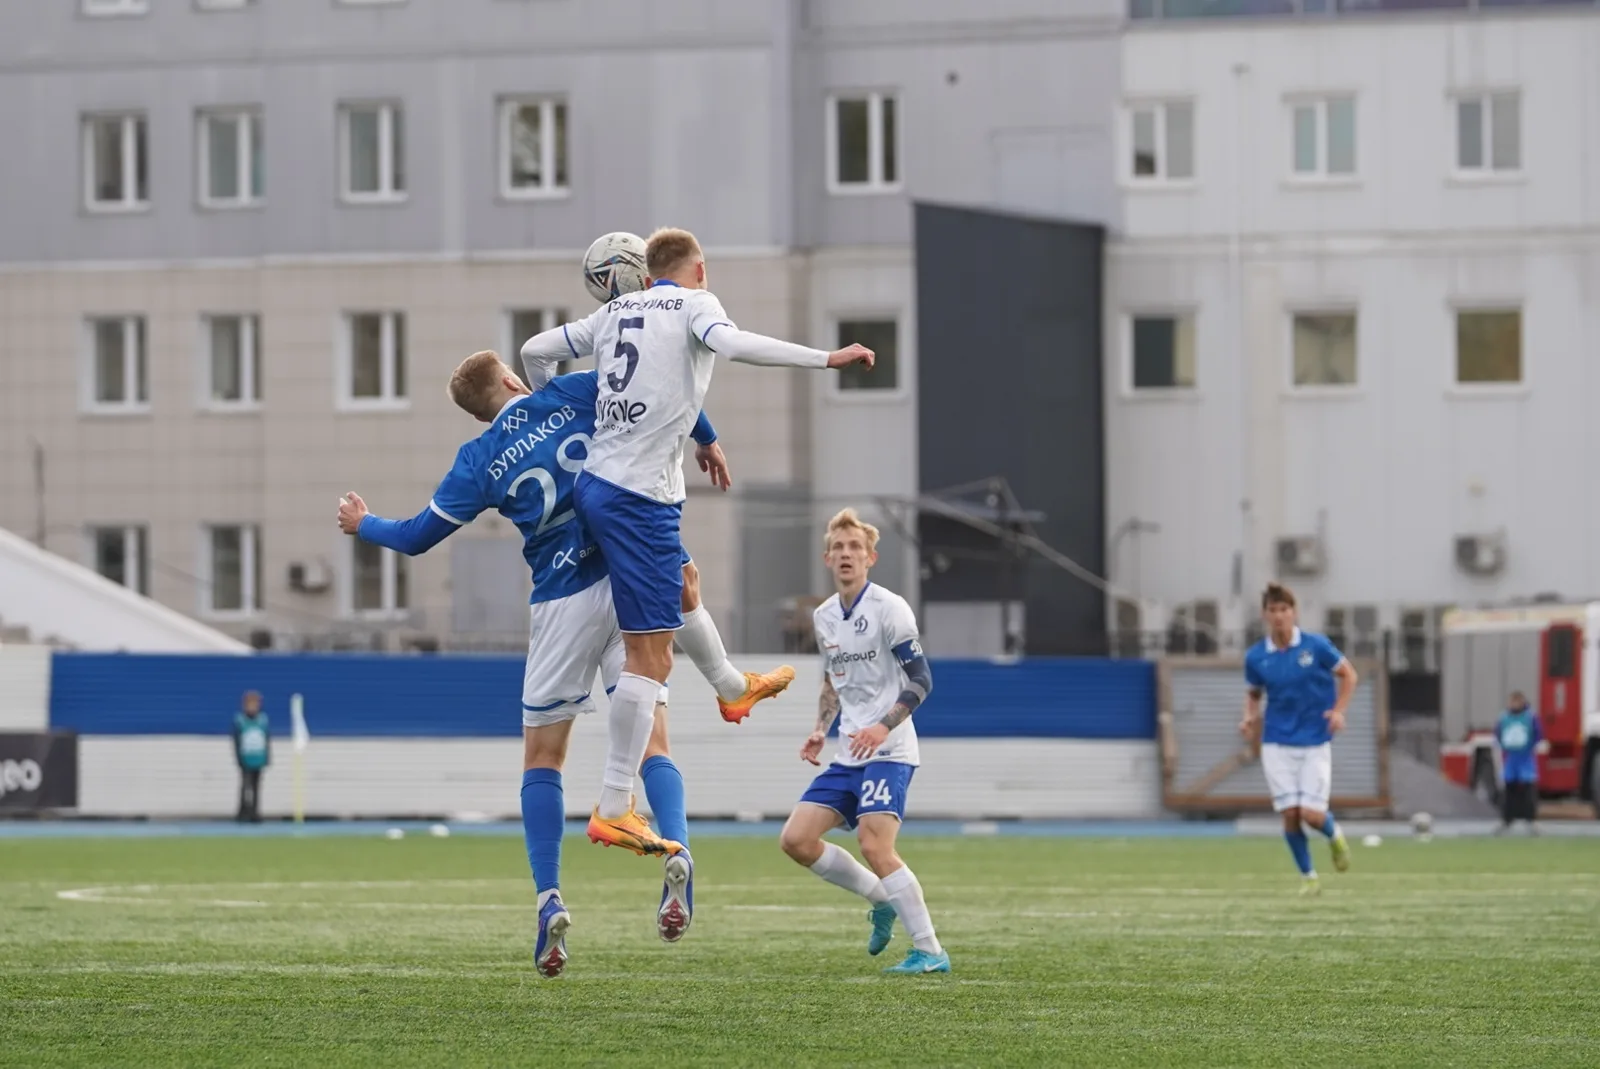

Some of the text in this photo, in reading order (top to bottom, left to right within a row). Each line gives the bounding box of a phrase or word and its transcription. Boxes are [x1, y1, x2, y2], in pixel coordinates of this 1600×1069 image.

[607, 316, 645, 393] 5
[488, 404, 576, 481] БУРЛАКОВ
[861, 779, 892, 808] 24
